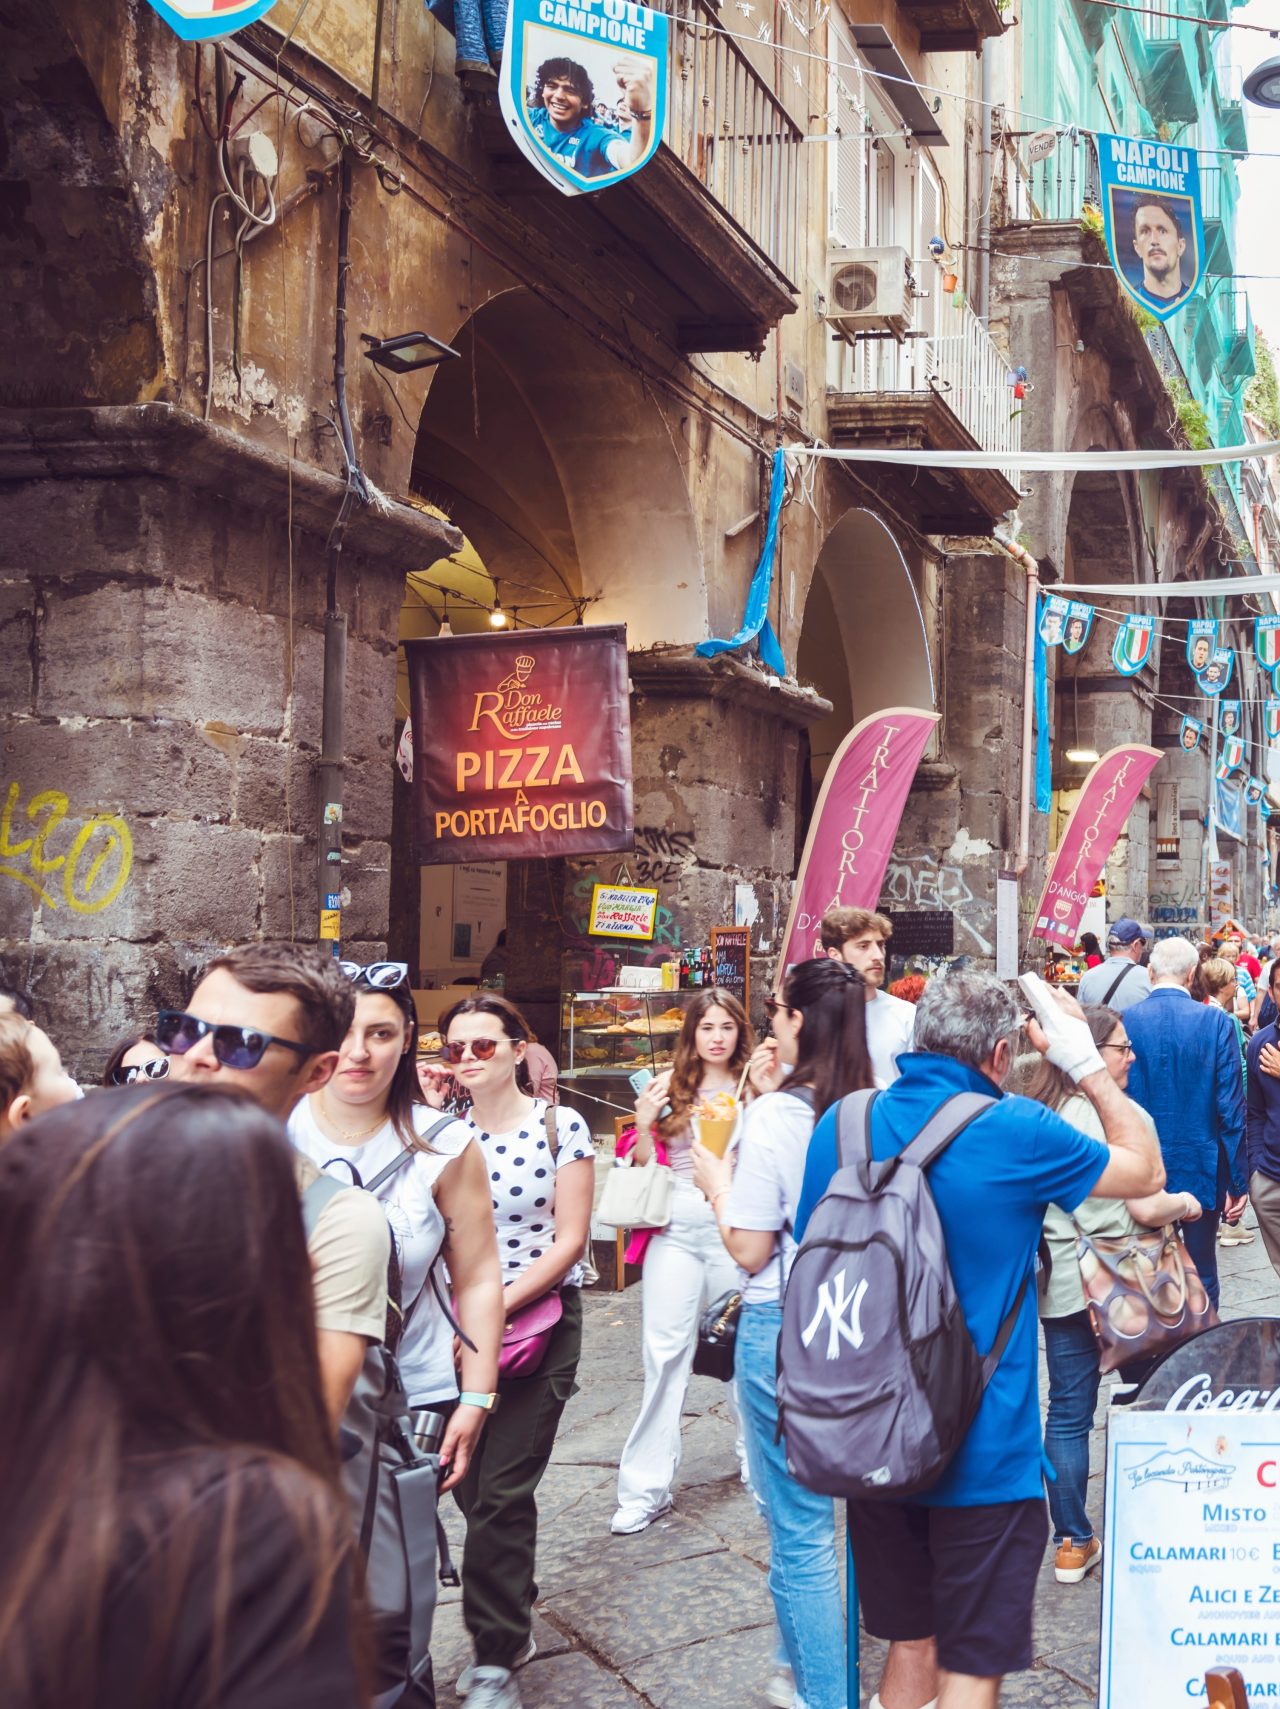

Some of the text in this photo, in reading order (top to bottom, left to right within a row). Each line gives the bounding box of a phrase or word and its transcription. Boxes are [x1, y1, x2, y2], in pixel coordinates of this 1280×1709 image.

[539, 2, 646, 50] CAMPIONE
[1110, 138, 1189, 174] NAPOLI
[1116, 163, 1186, 192] CAMPIONE
[467, 692, 562, 740] Raffaele
[504, 690, 542, 710] Don
[456, 743, 585, 792] PIZZA
[514, 789, 529, 806] A
[435, 800, 607, 839] PORTAFOGLIO
[825, 725, 900, 913] TRATTORIA
[1066, 755, 1136, 886] TRATTORIA
[801, 1268, 869, 1361] NY
[1130, 1542, 1226, 1561] CALAMARI
[1189, 1585, 1237, 1603] ALICI
[1244, 1588, 1253, 1603] E
[1171, 1628, 1267, 1646] CALAMARI
